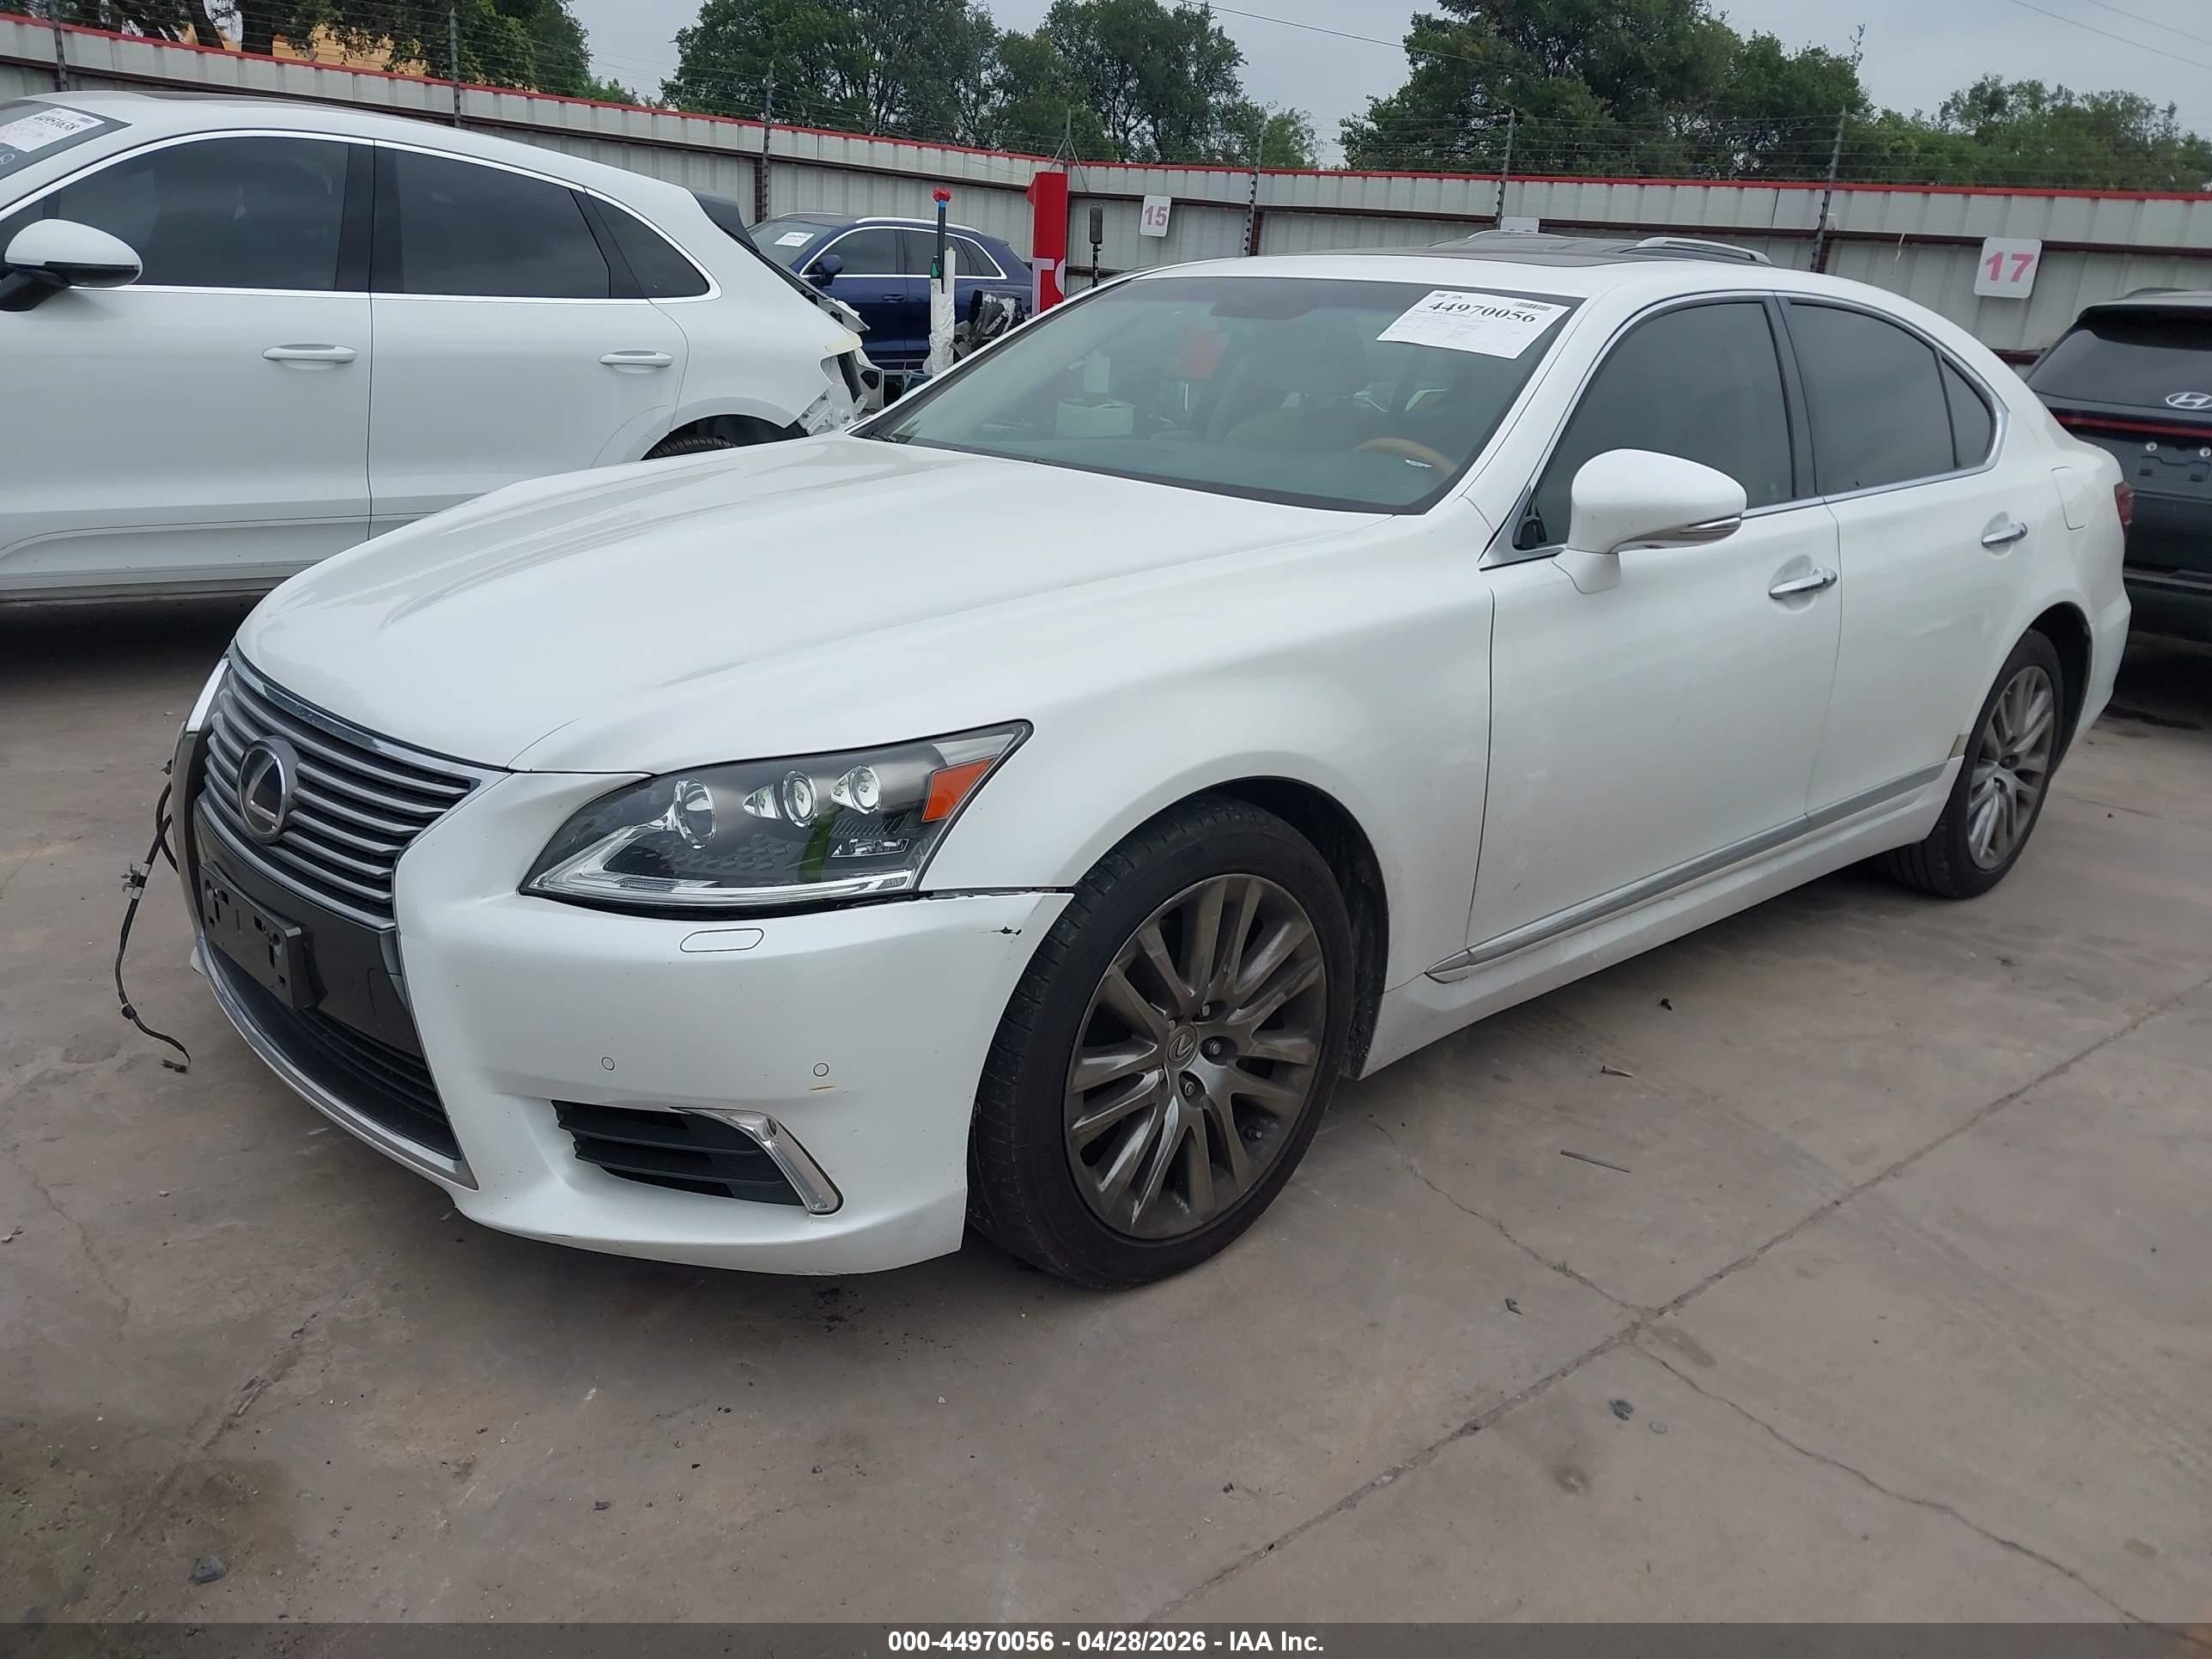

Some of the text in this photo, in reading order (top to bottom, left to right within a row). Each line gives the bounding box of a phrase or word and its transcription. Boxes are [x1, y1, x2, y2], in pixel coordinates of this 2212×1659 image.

[1144, 205, 1168, 227] 15
[1984, 252, 2035, 283] 17
[1428, 301, 1541, 323] 44970056
